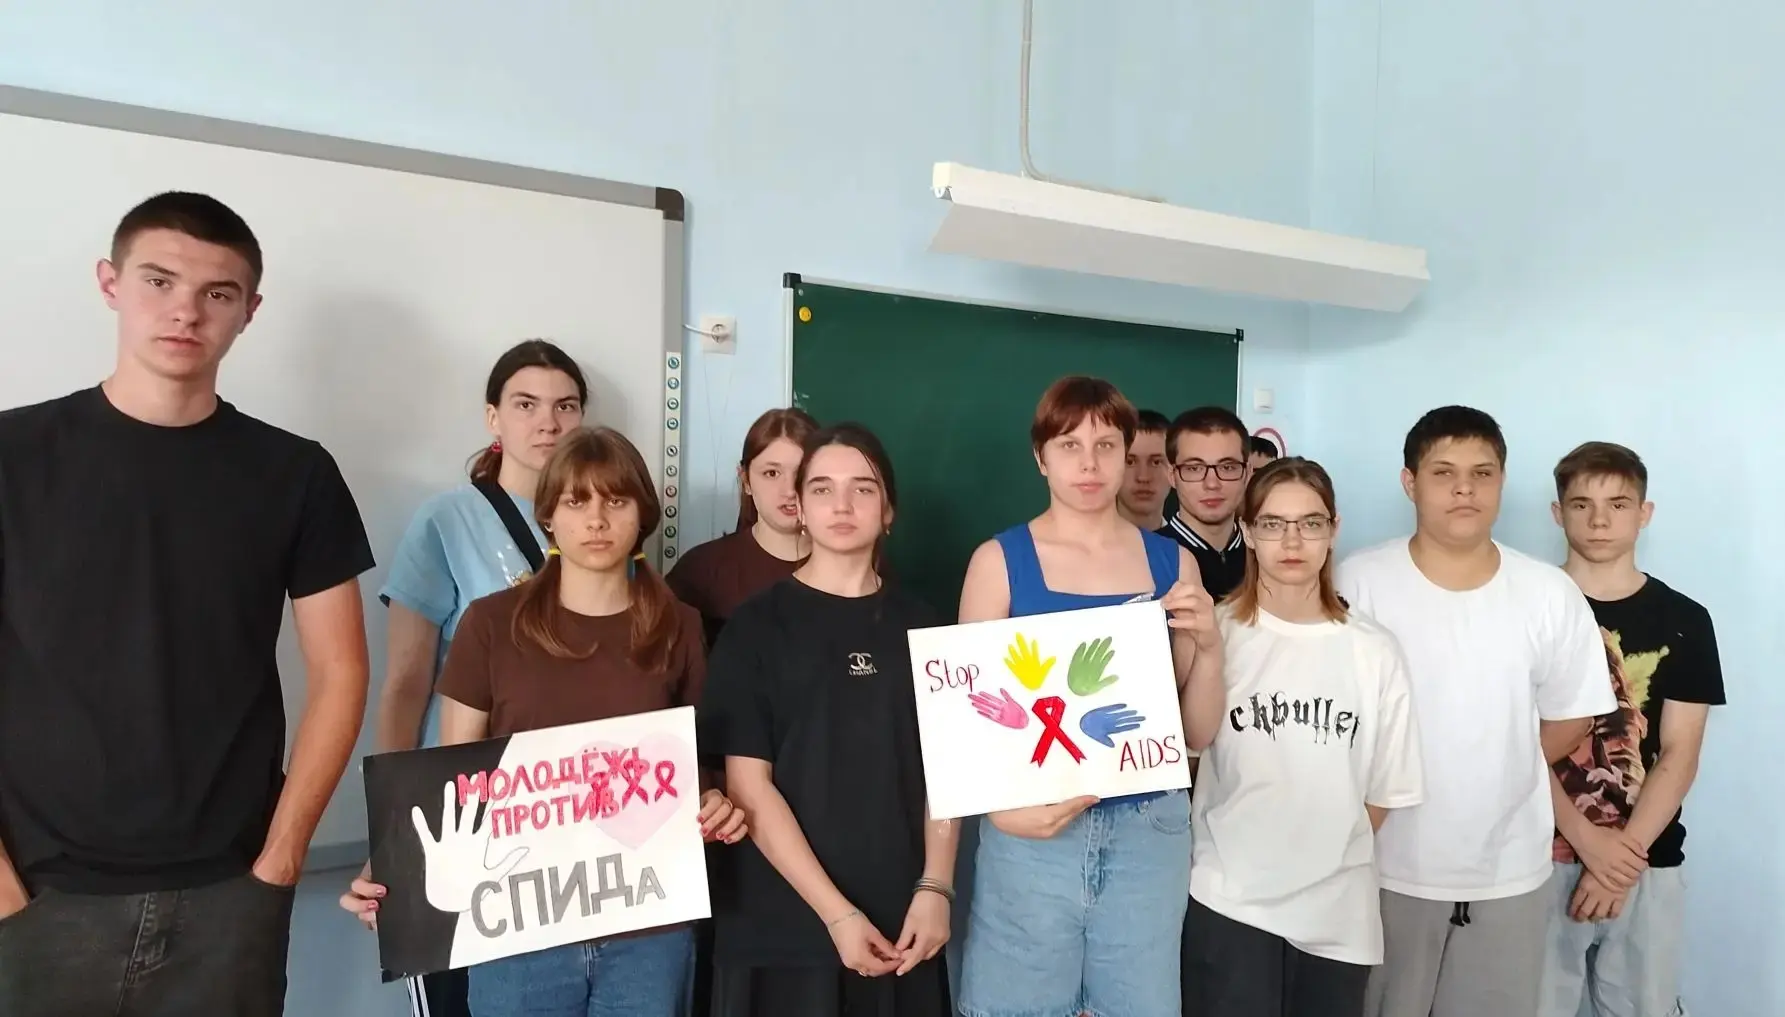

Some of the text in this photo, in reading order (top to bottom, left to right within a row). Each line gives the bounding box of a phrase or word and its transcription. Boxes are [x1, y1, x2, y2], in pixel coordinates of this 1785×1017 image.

[925, 659, 980, 692] Stop
[456, 747, 650, 806] МОЛОДЁЖЬ
[1119, 735, 1181, 772] AIDS
[491, 789, 620, 838] ПРОТИВ
[471, 853, 666, 938] СПИДА
